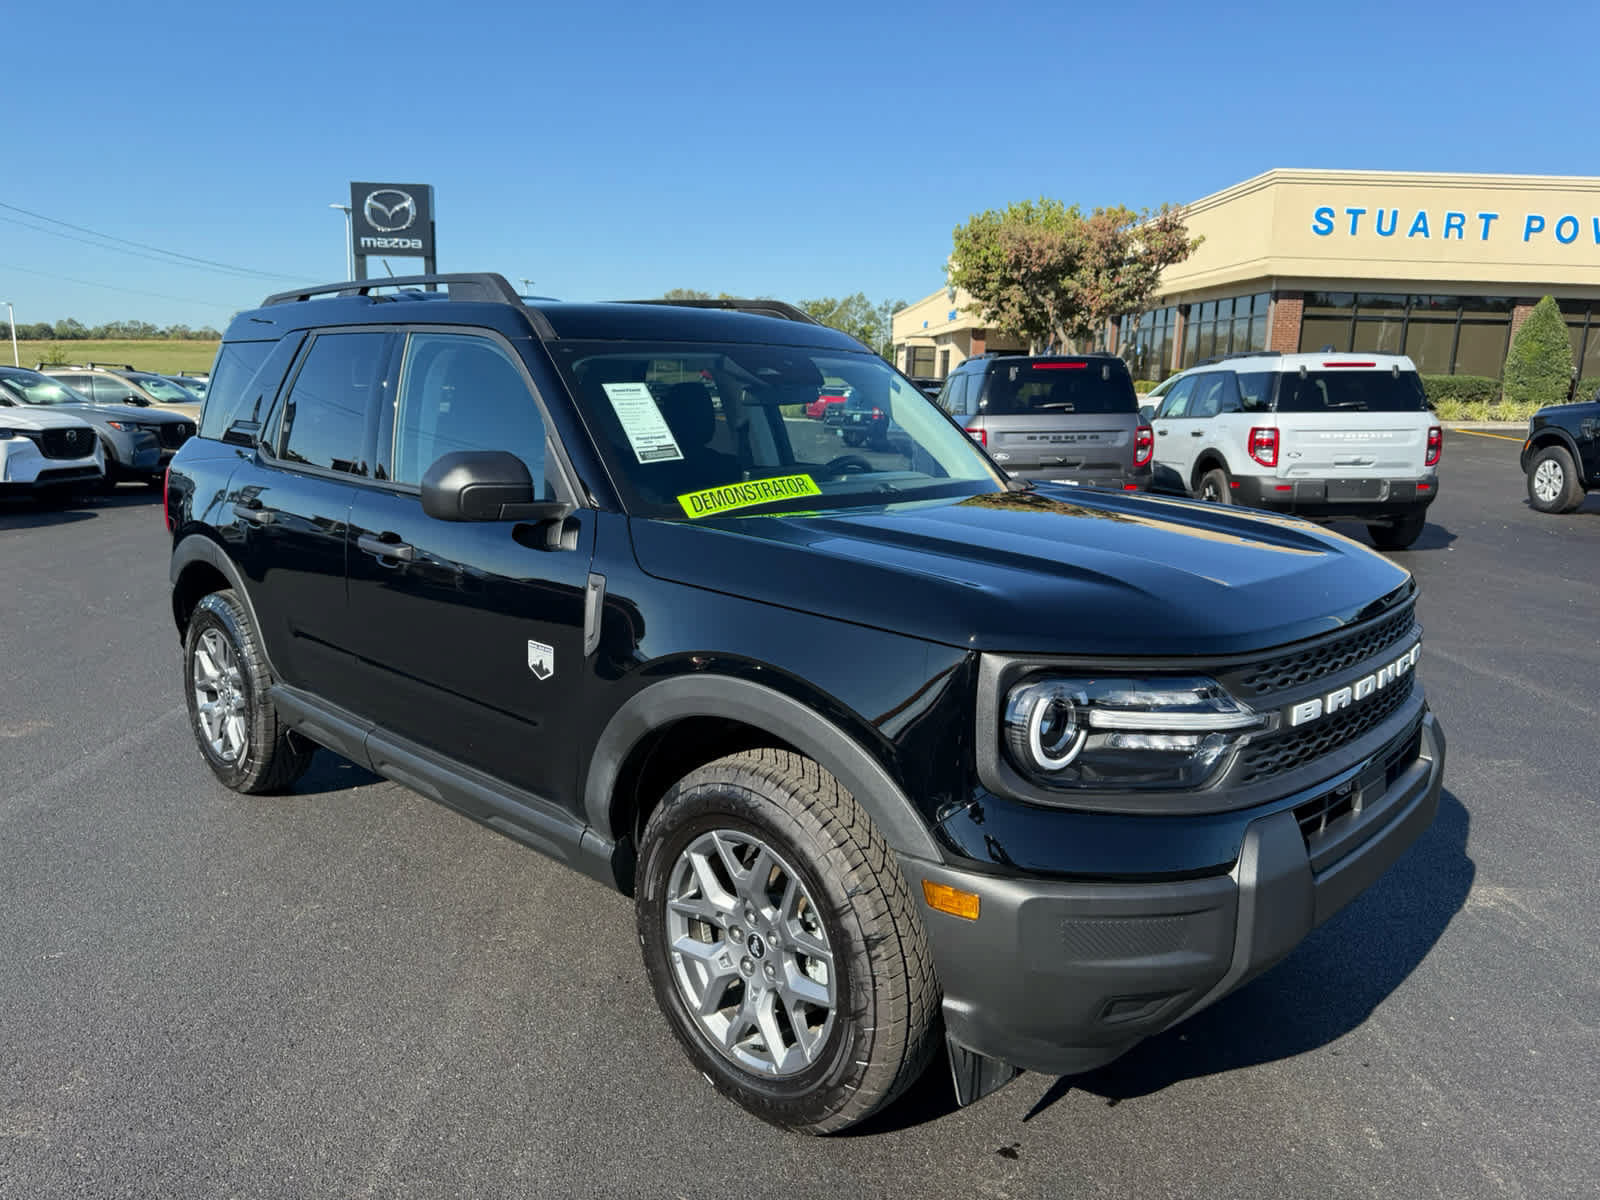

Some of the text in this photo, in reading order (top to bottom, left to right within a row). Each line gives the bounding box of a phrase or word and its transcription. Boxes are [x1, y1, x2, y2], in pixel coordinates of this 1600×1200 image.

[1311, 206, 1600, 245] STUART PO
[689, 476, 810, 513] DEMONSTRATOR
[1291, 642, 1422, 727] BRONCO
